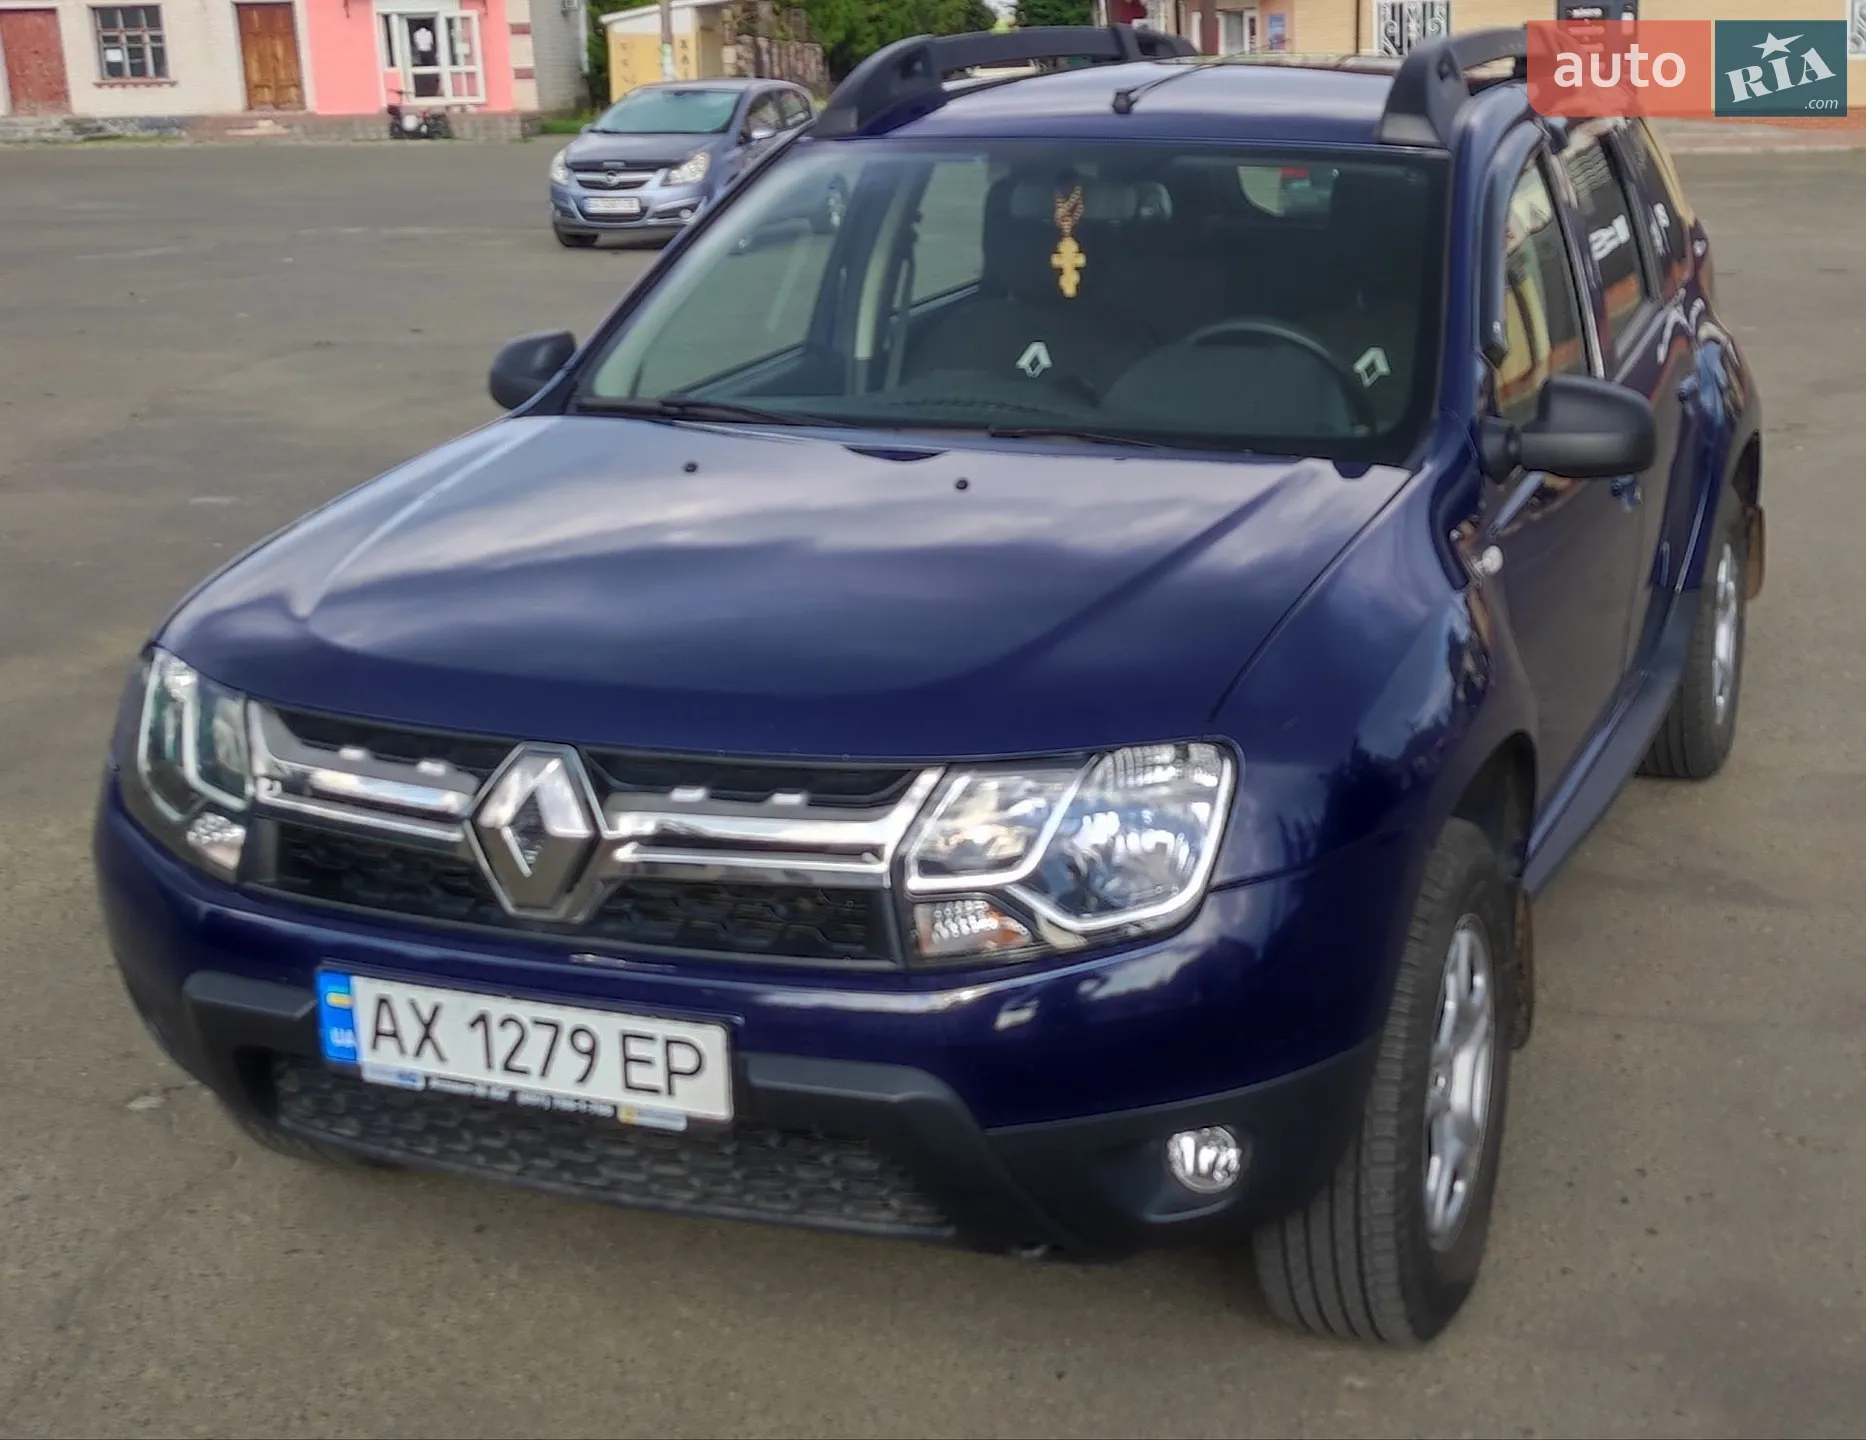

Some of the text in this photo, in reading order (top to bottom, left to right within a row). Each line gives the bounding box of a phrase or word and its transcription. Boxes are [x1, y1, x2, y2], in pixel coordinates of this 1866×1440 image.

[372, 996, 704, 1097] AX 1279 EP
